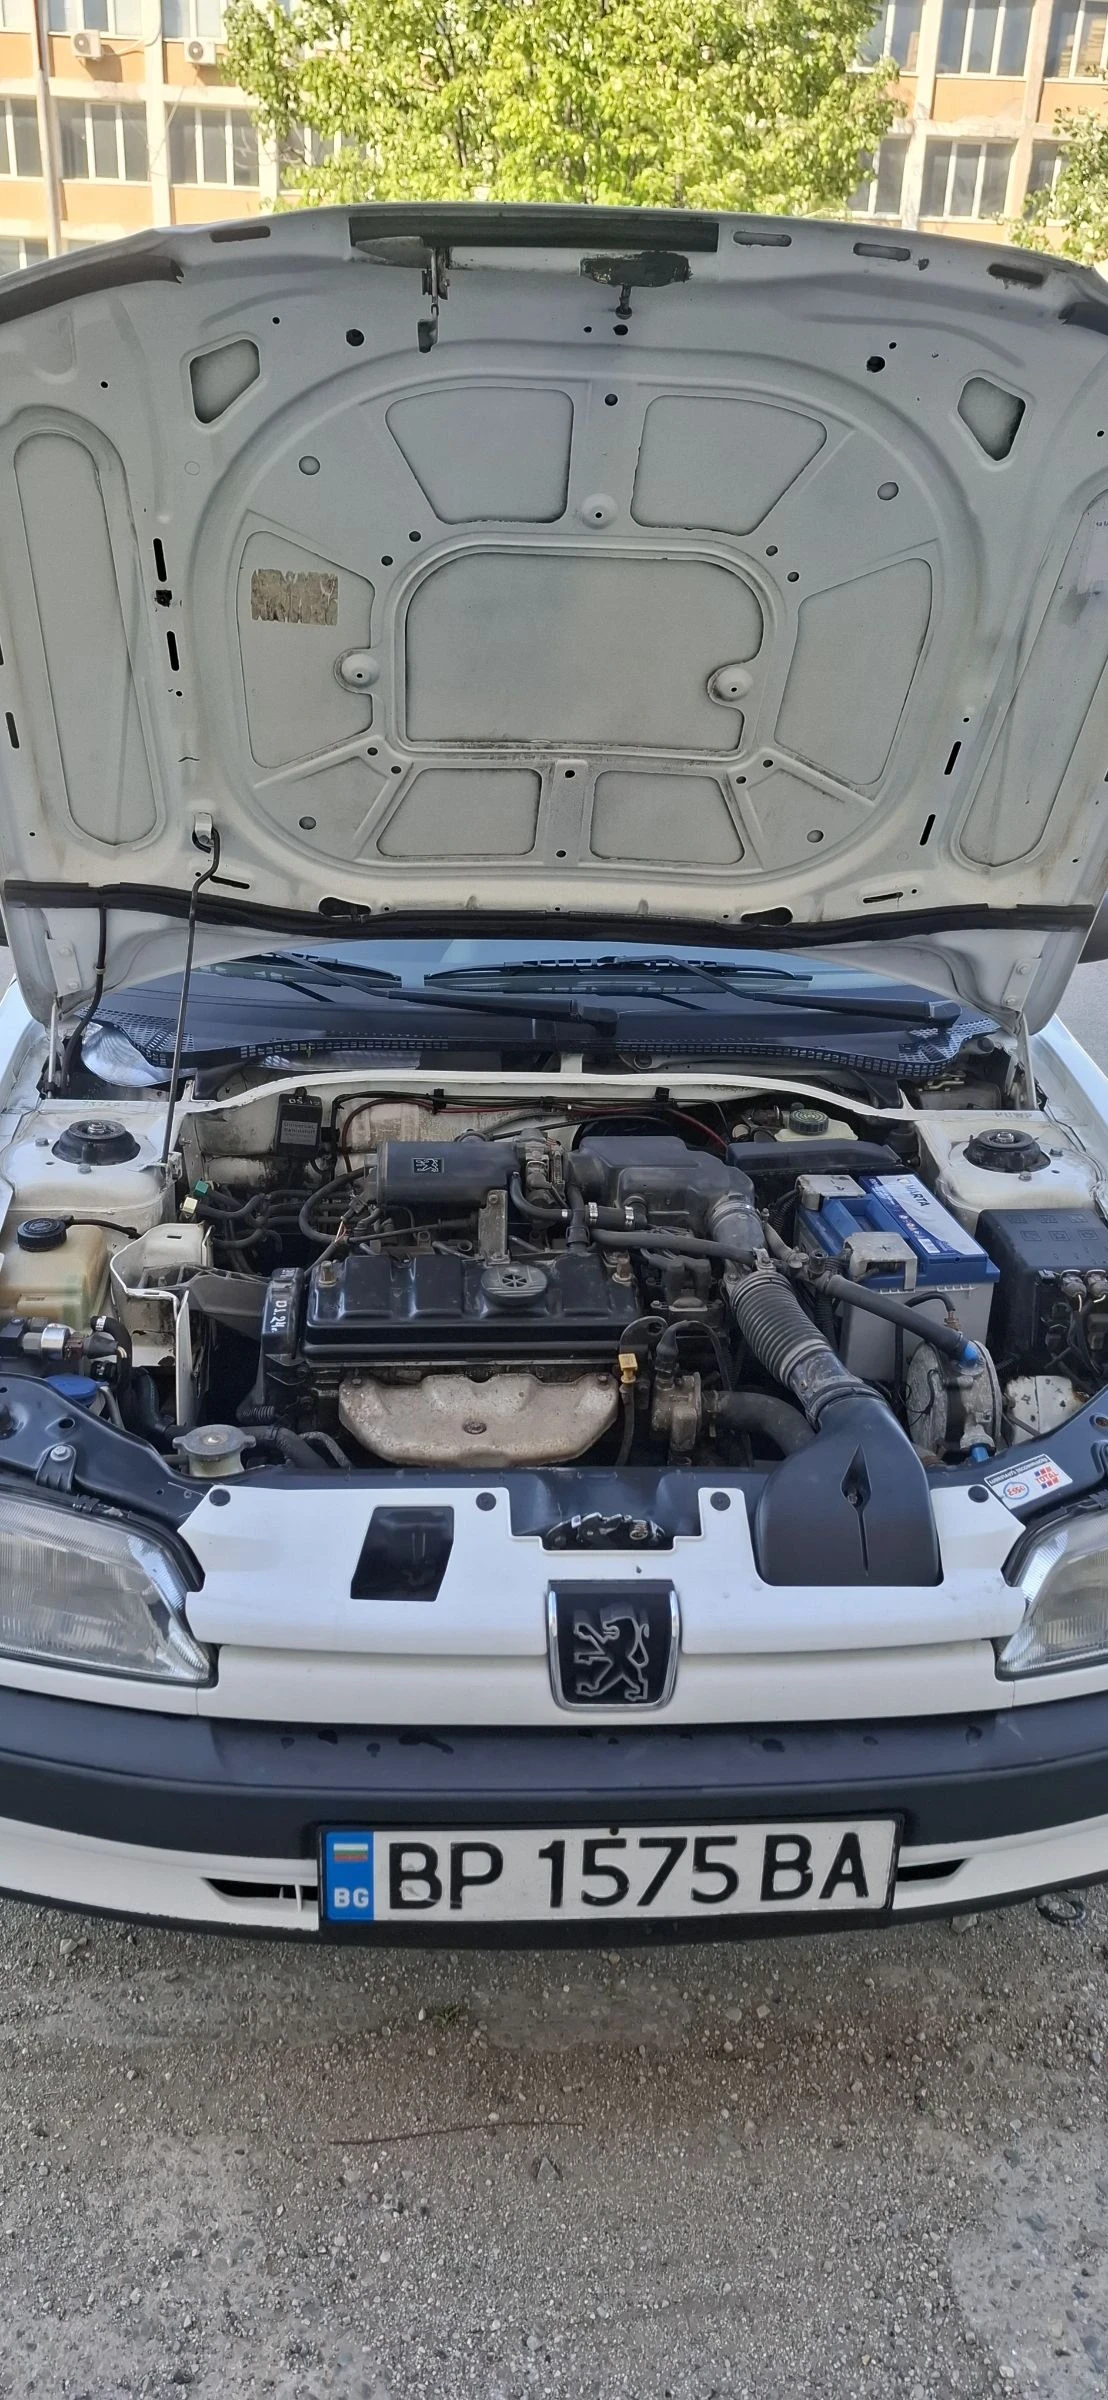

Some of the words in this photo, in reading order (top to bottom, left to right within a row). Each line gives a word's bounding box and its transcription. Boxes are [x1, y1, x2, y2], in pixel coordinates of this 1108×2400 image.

[906, 1183, 930, 1207] VARTA
[1035, 1471, 1059, 1484] TOTAL
[388, 1841, 504, 1910] BP
[537, 1835, 740, 1908] 1575
[759, 1831, 870, 1902] BA
[333, 1886, 369, 1908] BG
